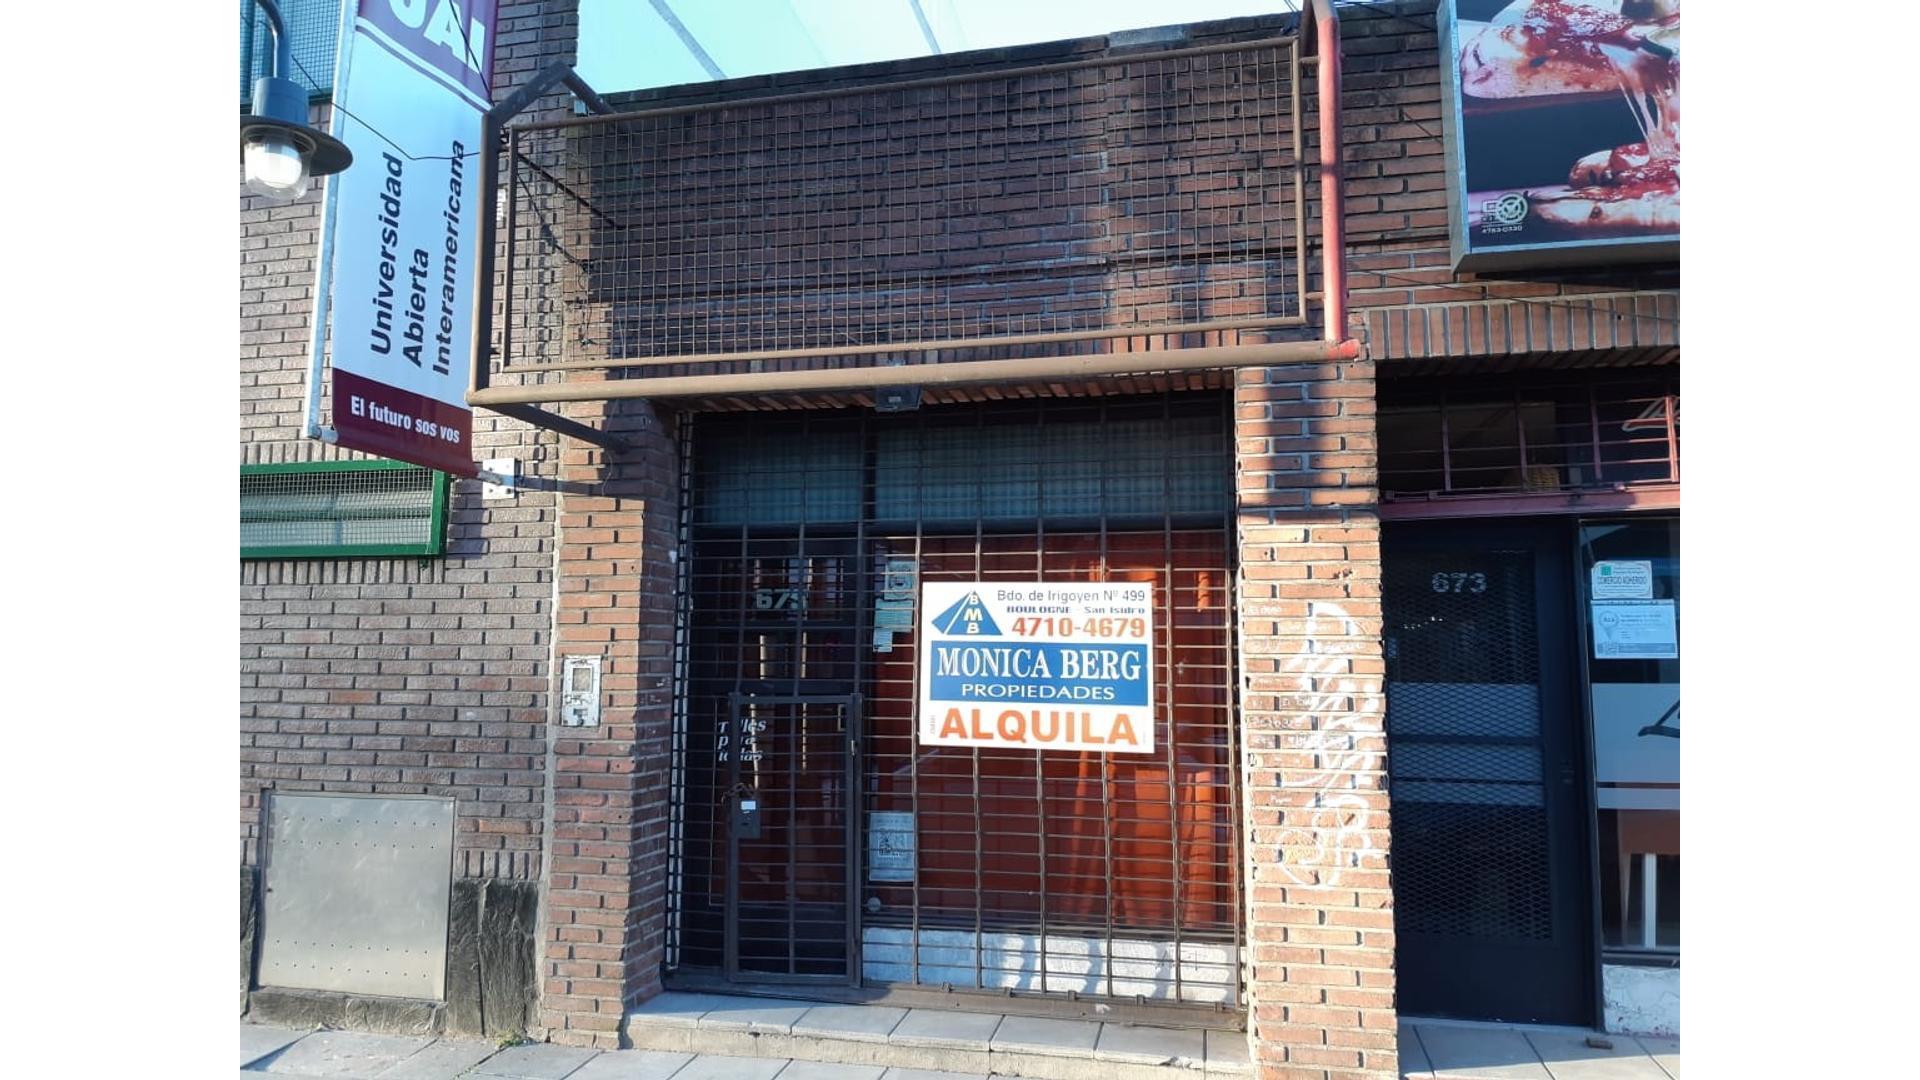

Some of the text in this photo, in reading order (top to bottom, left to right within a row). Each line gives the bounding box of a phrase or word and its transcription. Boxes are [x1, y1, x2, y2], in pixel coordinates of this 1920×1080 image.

[370, 152, 404, 356] Universidad
[433, 139, 465, 376] Interamericana
[401, 248, 430, 368] Abierta
[351, 395, 460, 443] El futuro sos vos
[997, 590, 1025, 601] Bdo.
[1029, 590, 1044, 601] de
[1048, 590, 1099, 604] Irigoyen
[1122, 590, 1146, 602] 499
[1432, 572, 1487, 593] 673
[1006, 606, 1146, 614] BOULOGNE San Isidro
[1012, 617, 1146, 638] 4710-4679
[936, 647, 1142, 681] MONICA BERG
[961, 683, 1116, 700] PROPIEDADES
[938, 707, 1139, 746] ALQUILA
